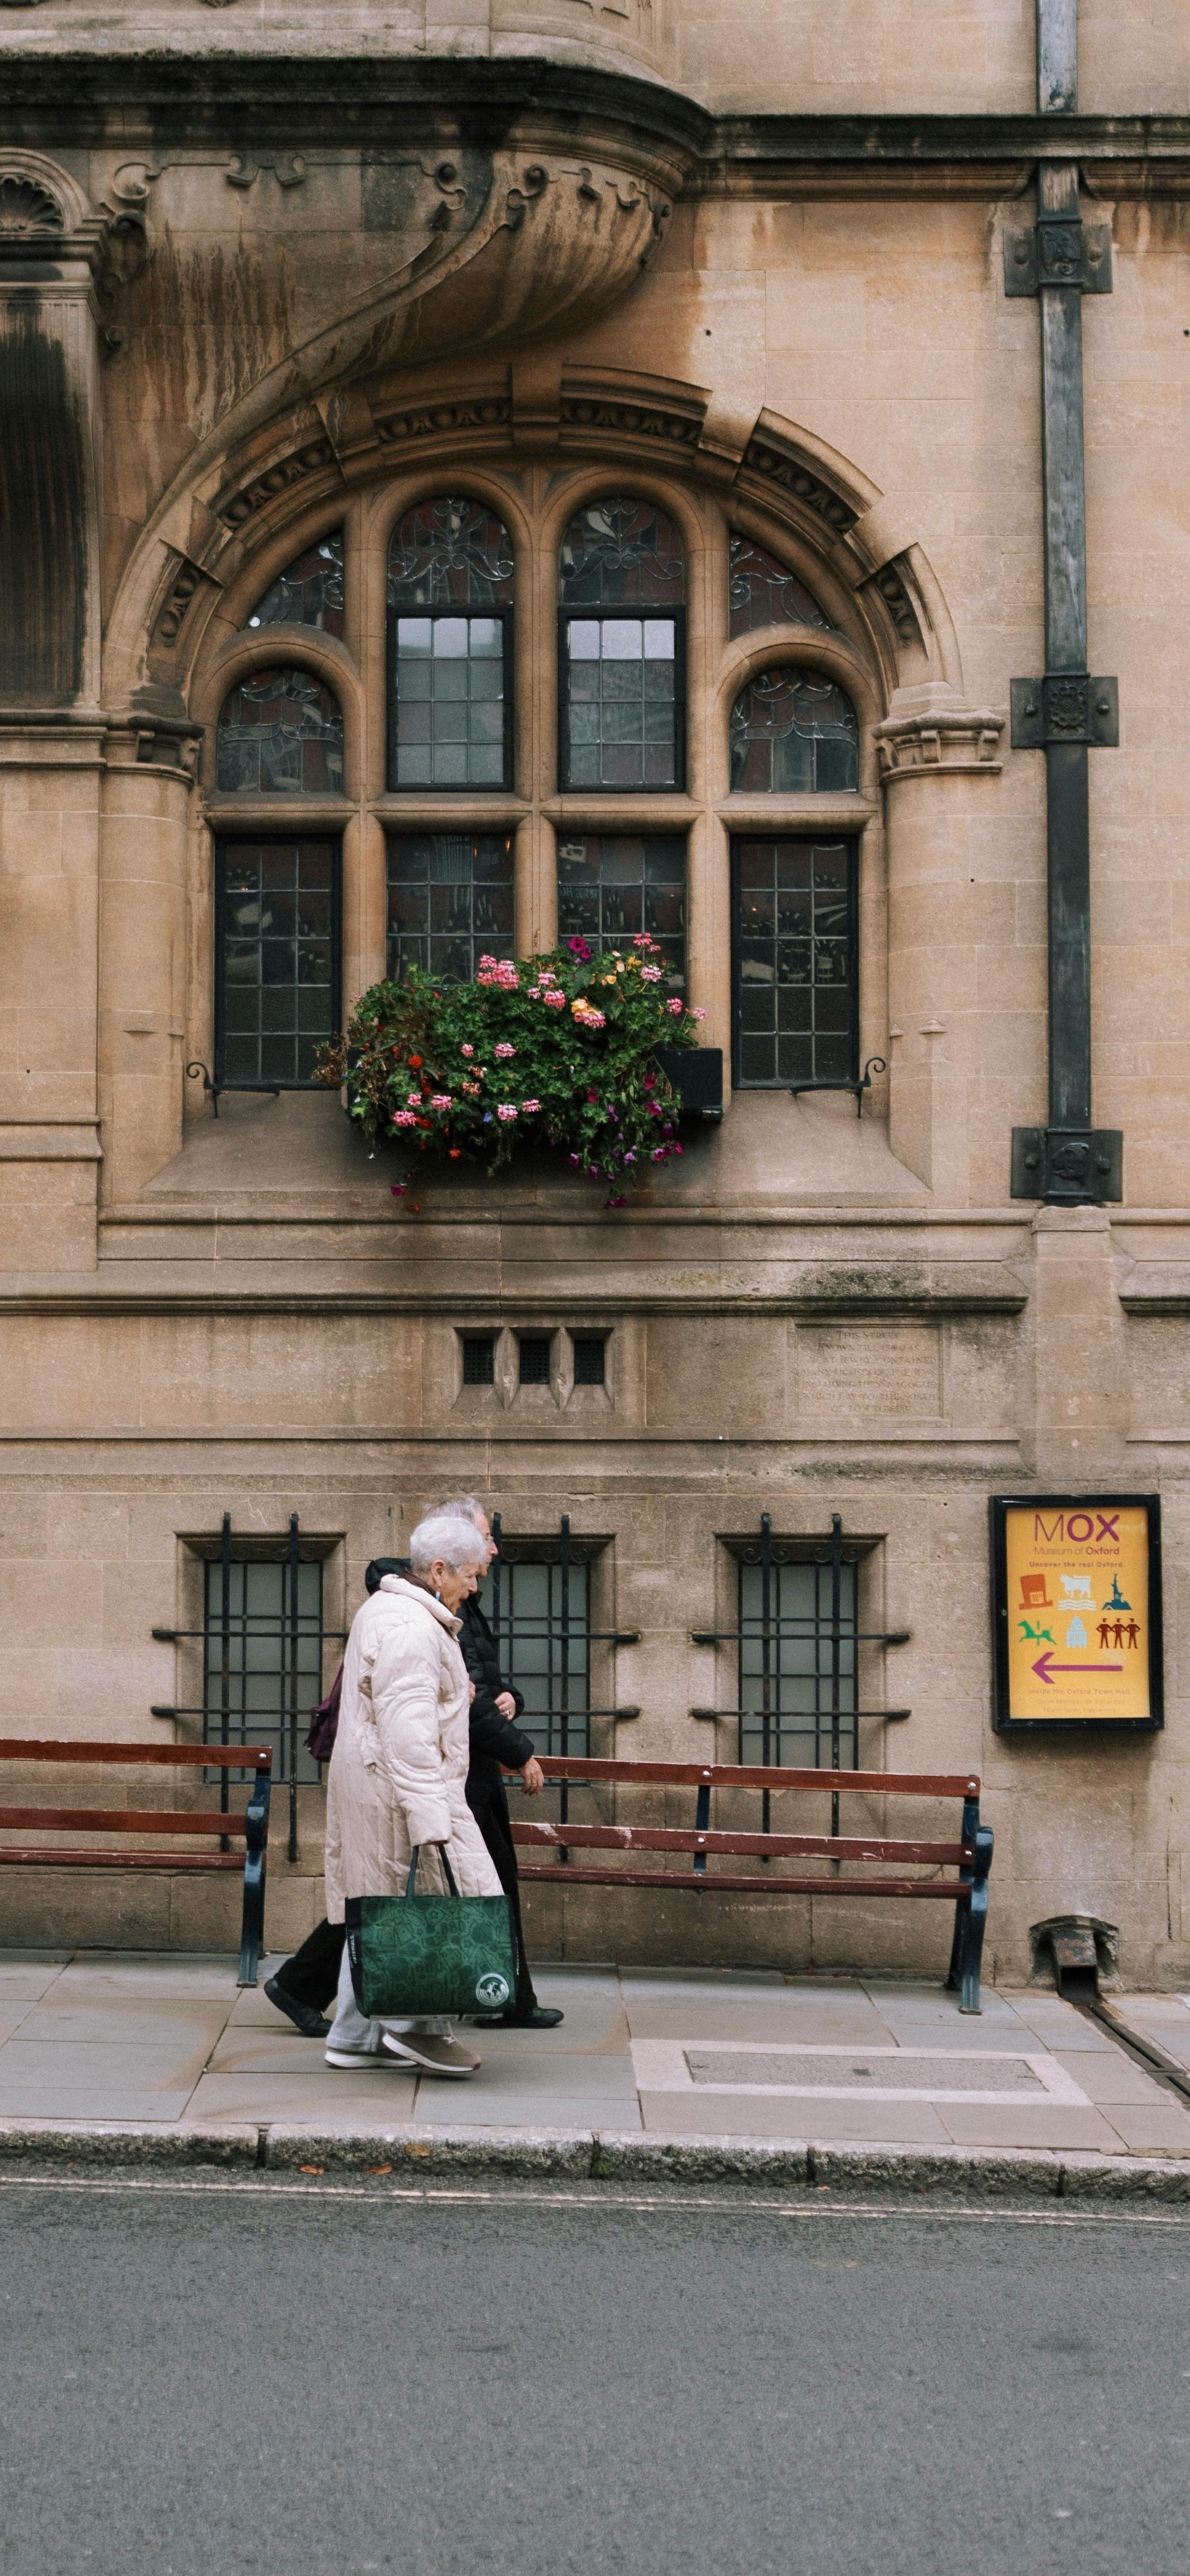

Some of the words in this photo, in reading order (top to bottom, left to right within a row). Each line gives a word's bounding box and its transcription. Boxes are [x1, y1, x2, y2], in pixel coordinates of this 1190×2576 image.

[876, 1355, 936, 1365] CONTAINED
[1034, 1514, 1120, 1542] MOX
[1034, 1547, 1073, 1555] Museum
[1075, 1547, 1083, 1555] of
[1086, 1547, 1120, 1556] Oxford
